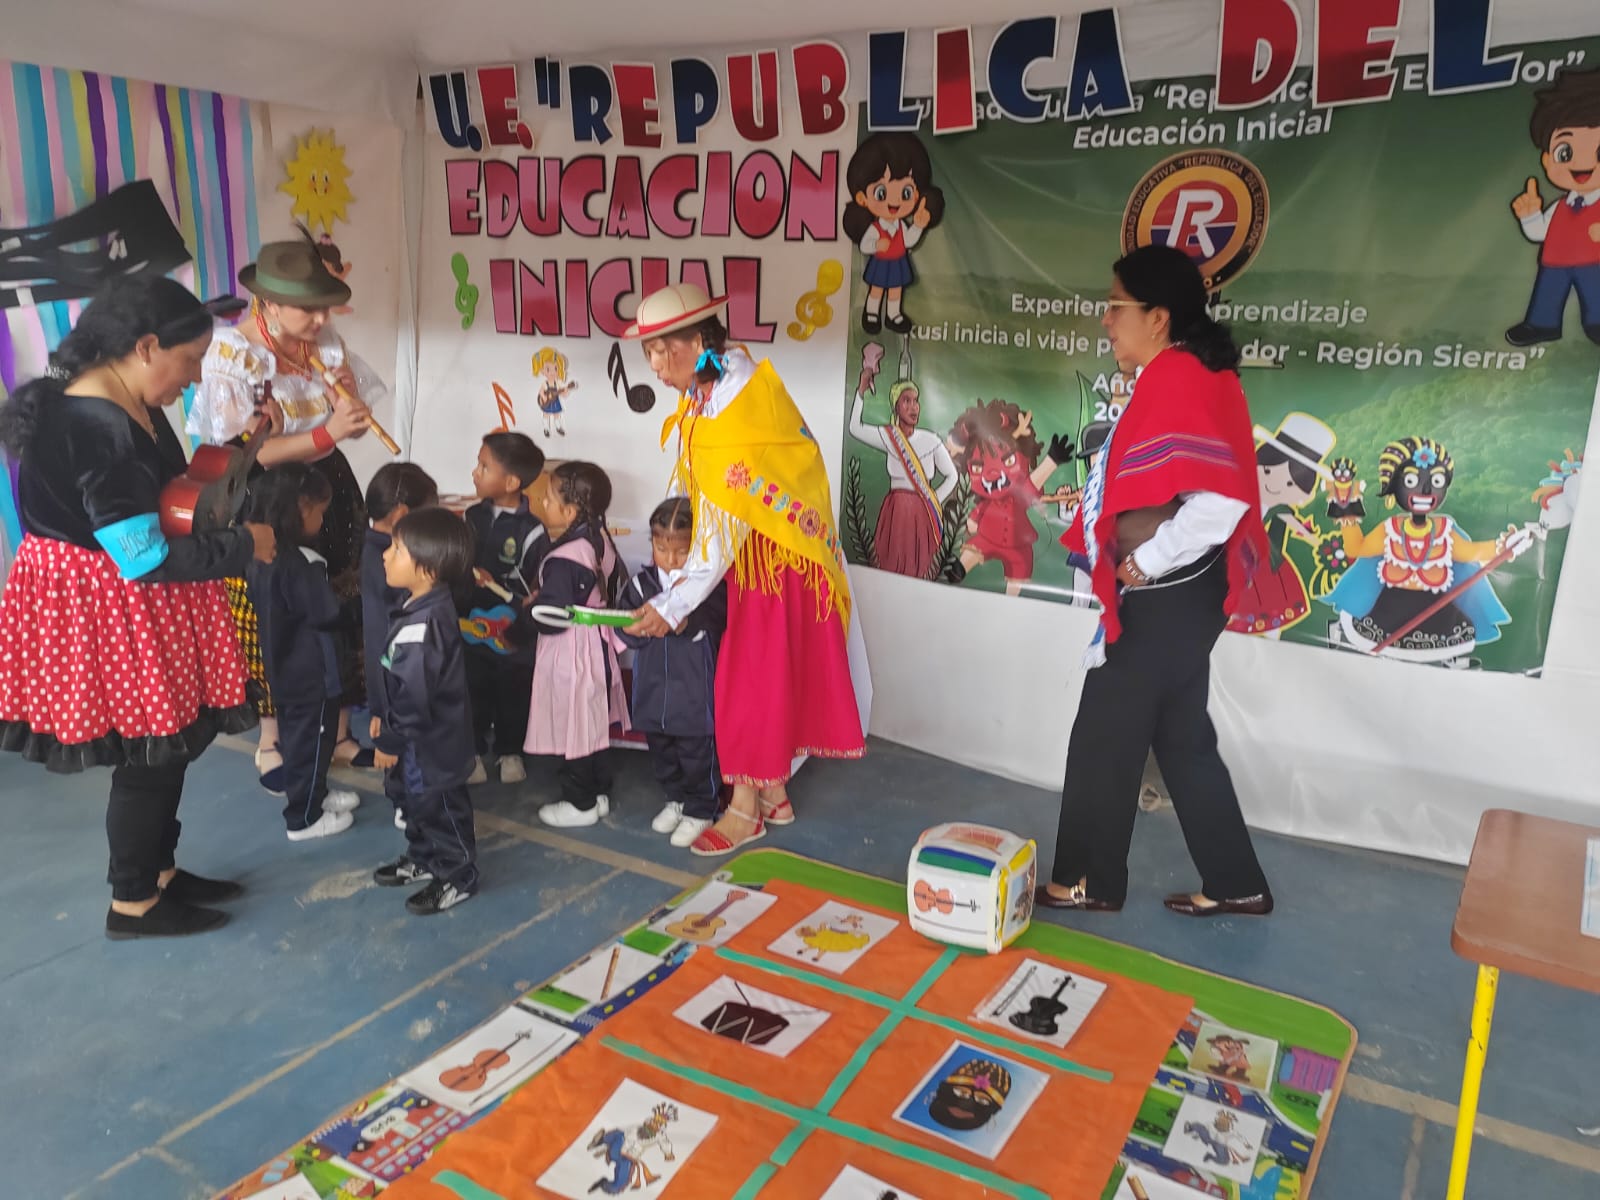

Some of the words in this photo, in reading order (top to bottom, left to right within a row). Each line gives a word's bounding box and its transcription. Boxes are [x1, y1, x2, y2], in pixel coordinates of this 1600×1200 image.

[1215, 0, 1522, 110] DEL
[1073, 118, 1226, 149] Educación
[1236, 106, 1334, 142] Inicial
[445, 150, 839, 241] EDUCACION
[1011, 293, 1109, 318] Experien
[1206, 299, 1368, 328] prendizaje
[954, 322, 1009, 346] inicia
[1014, 328, 1031, 349] el
[1037, 330, 1090, 356] viaje
[1316, 340, 1423, 371] Región
[1094, 401, 1123, 422] 20
